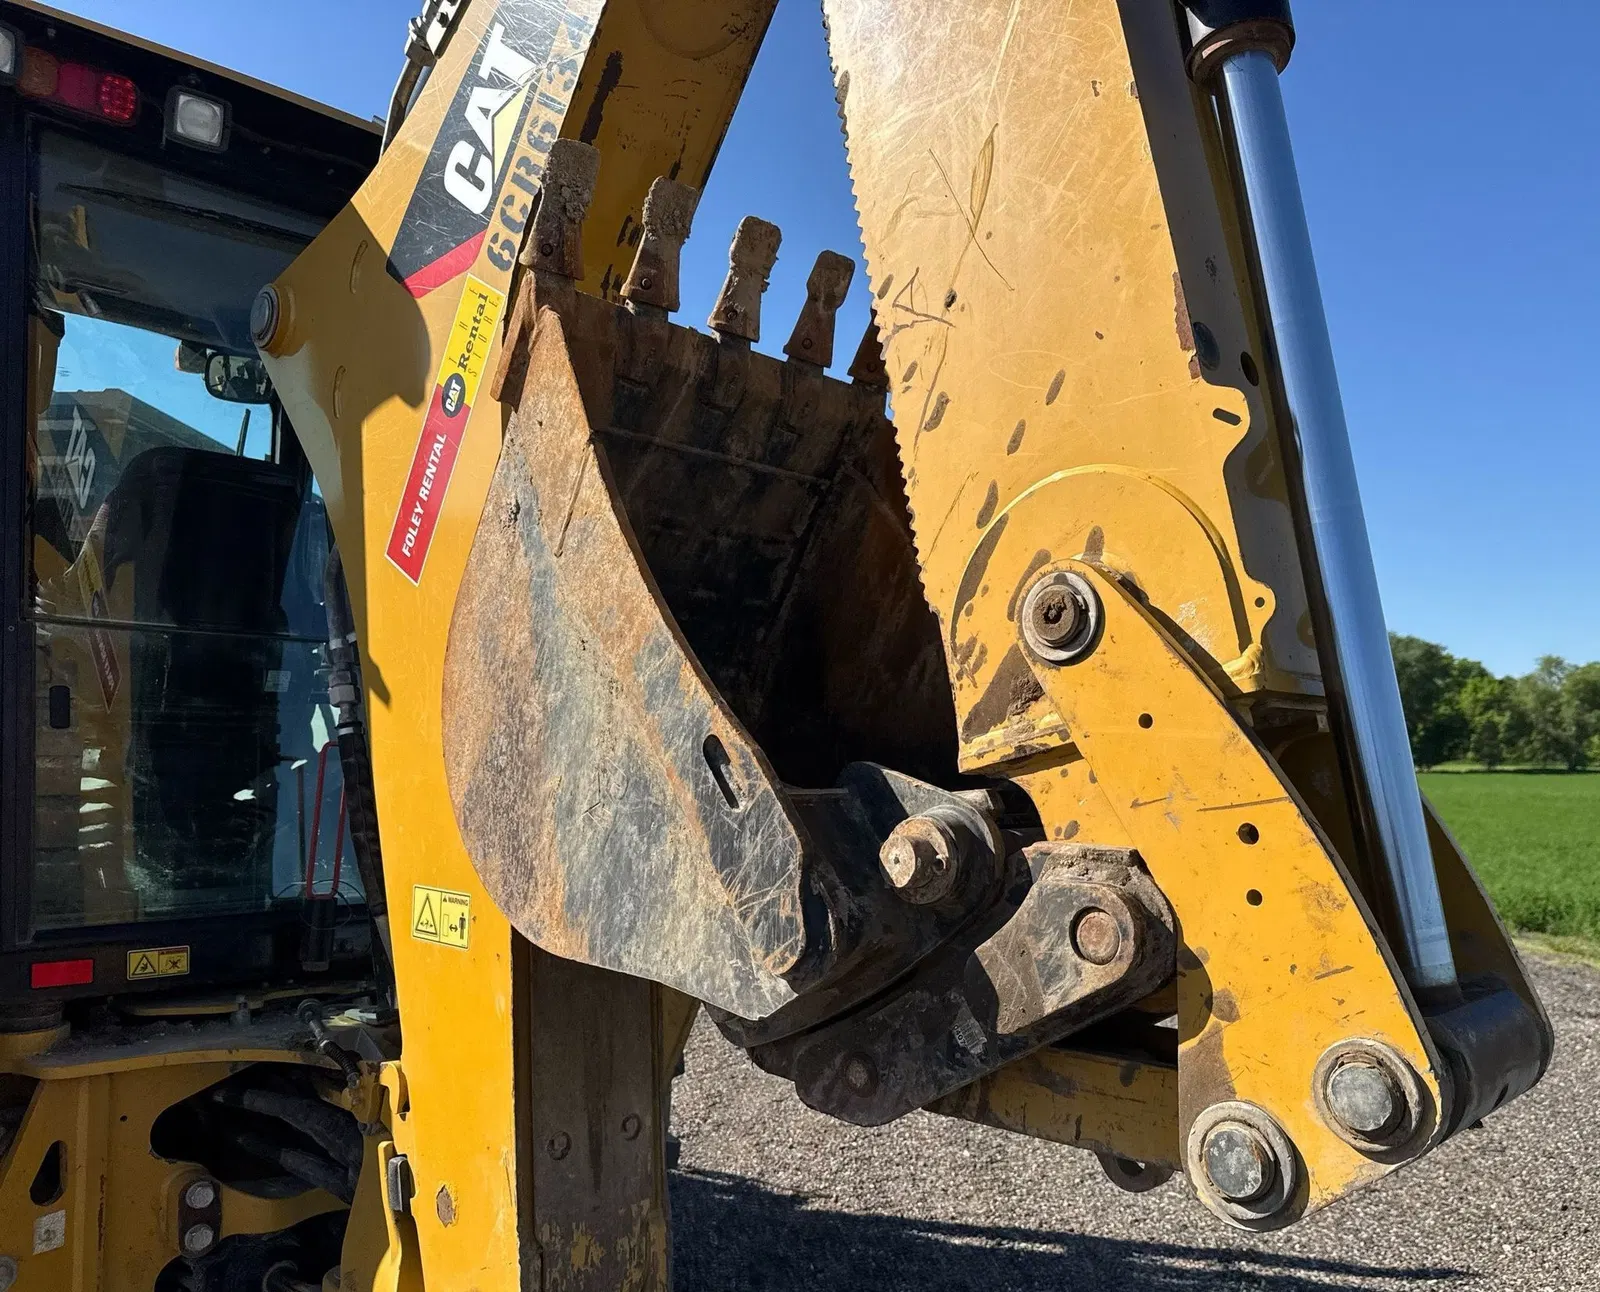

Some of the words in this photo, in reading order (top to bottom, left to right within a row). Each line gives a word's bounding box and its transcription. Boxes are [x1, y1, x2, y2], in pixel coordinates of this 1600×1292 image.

[444, 22, 540, 215] CAT
[445, 379, 466, 413] CAT
[457, 292, 488, 372] Rental
[402, 499, 428, 558] FOLEY
[418, 432, 448, 502] RENTAL
